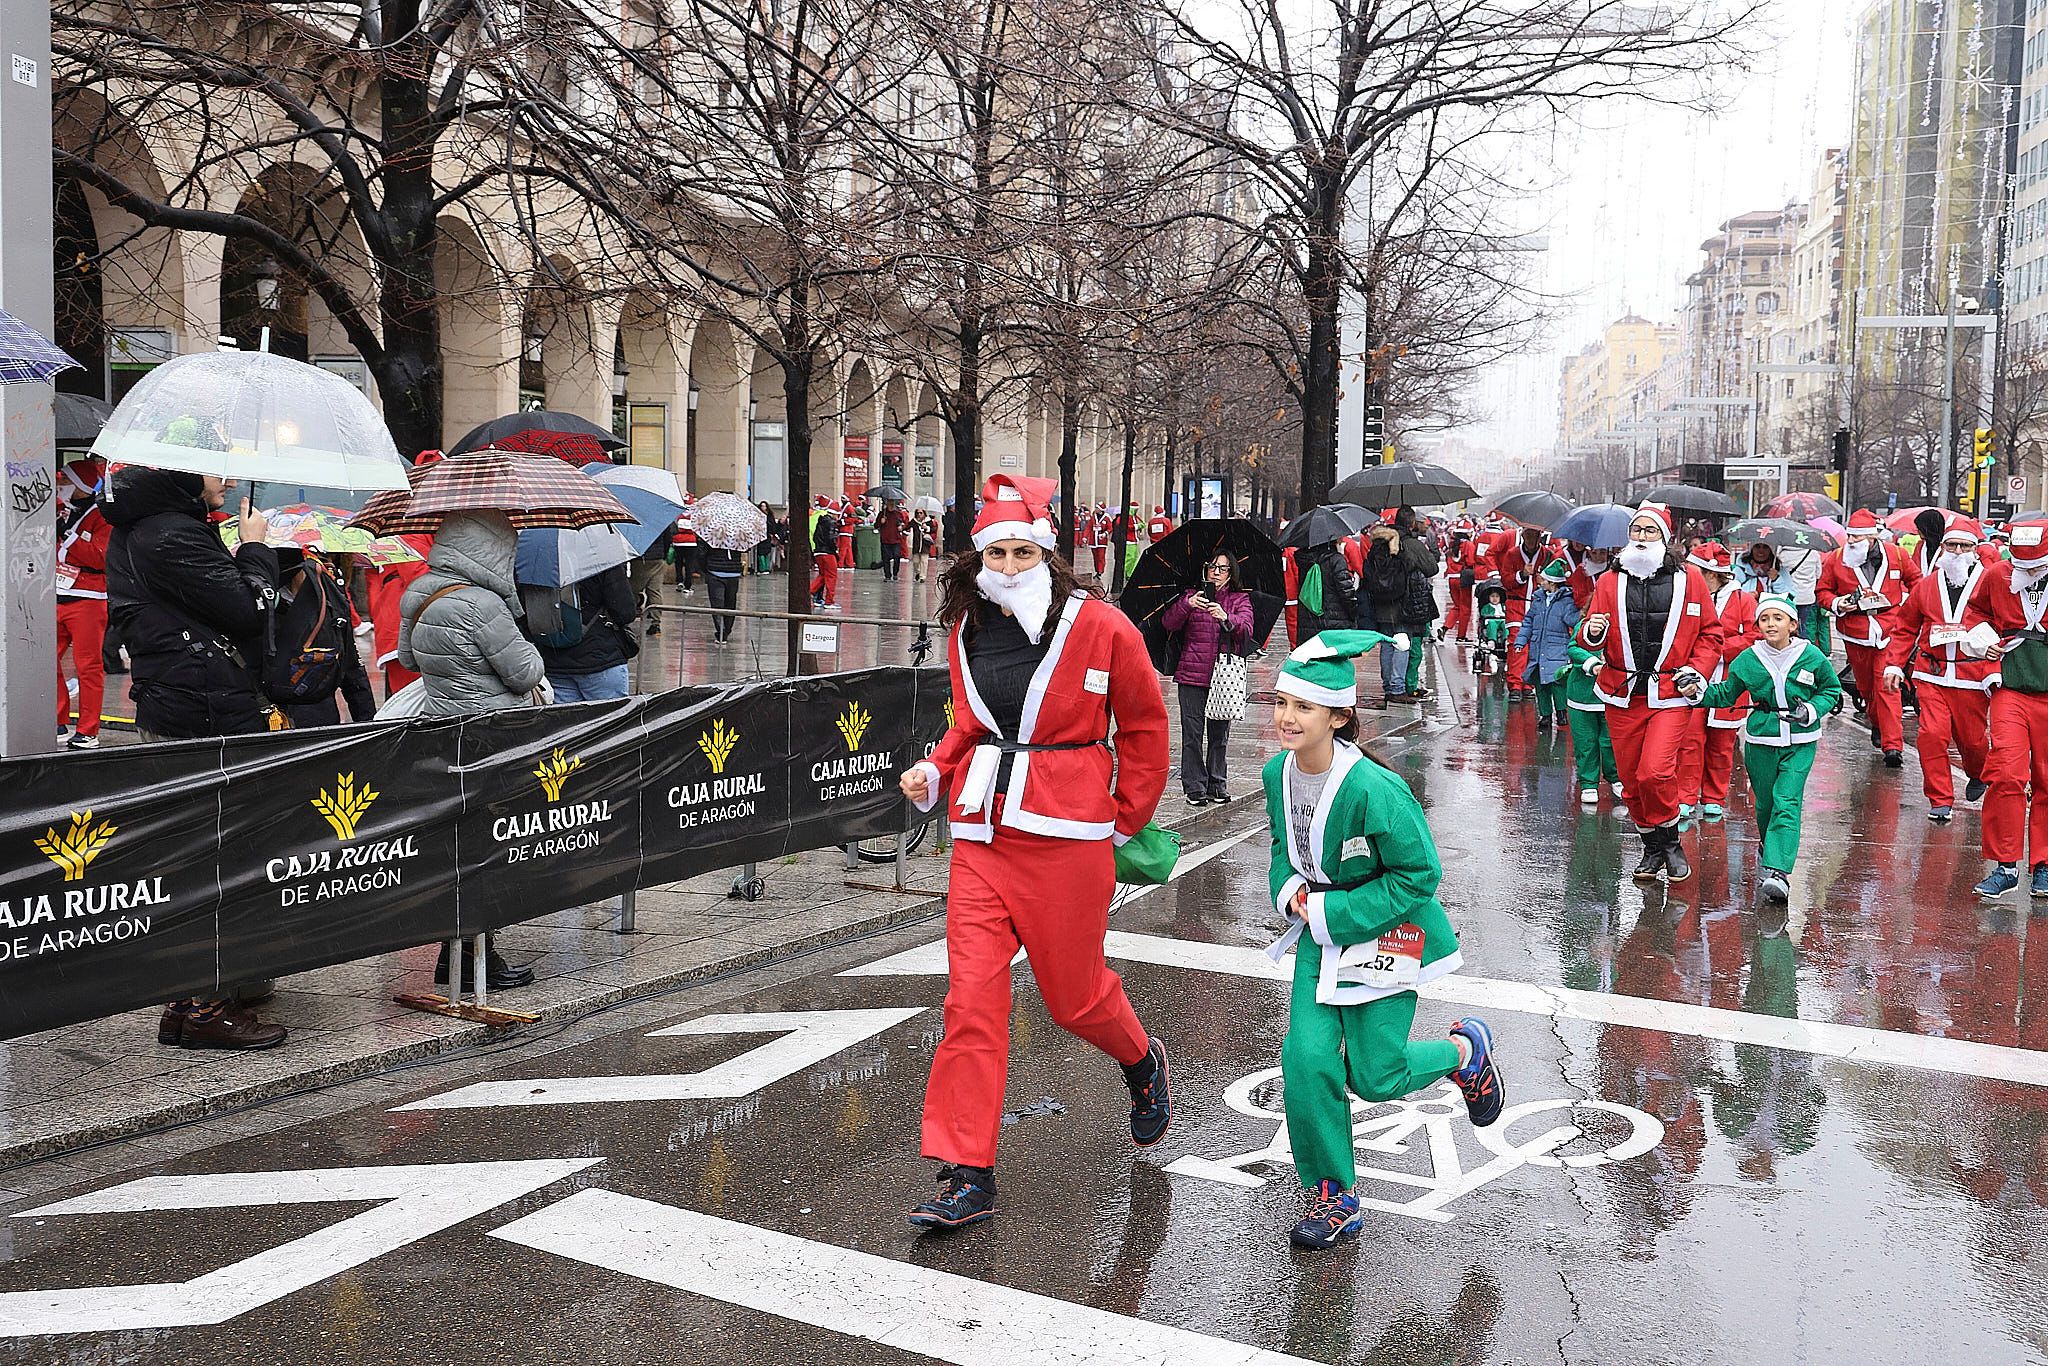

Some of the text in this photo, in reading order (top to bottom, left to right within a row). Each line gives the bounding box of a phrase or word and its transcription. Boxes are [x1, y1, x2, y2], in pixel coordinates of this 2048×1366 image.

[812, 634, 835, 642] Zaragoza
[811, 752, 893, 781] CAJA RURAL
[667, 772, 766, 808] CAJA RURAL
[821, 775, 883, 801] DE ARAGÓN
[492, 799, 612, 842] CAJA RURAL
[679, 800, 755, 829] DE ARAGÓN
[265, 834, 419, 883] CAJA RURAL
[507, 830, 599, 864] DE ARAGÓN
[0, 876, 171, 929] AJA RURAL
[281, 867, 401, 907] DE ARAGÓN
[0, 916, 151, 962] DE ARAGÓN
[1395, 929, 1420, 943] Noel
